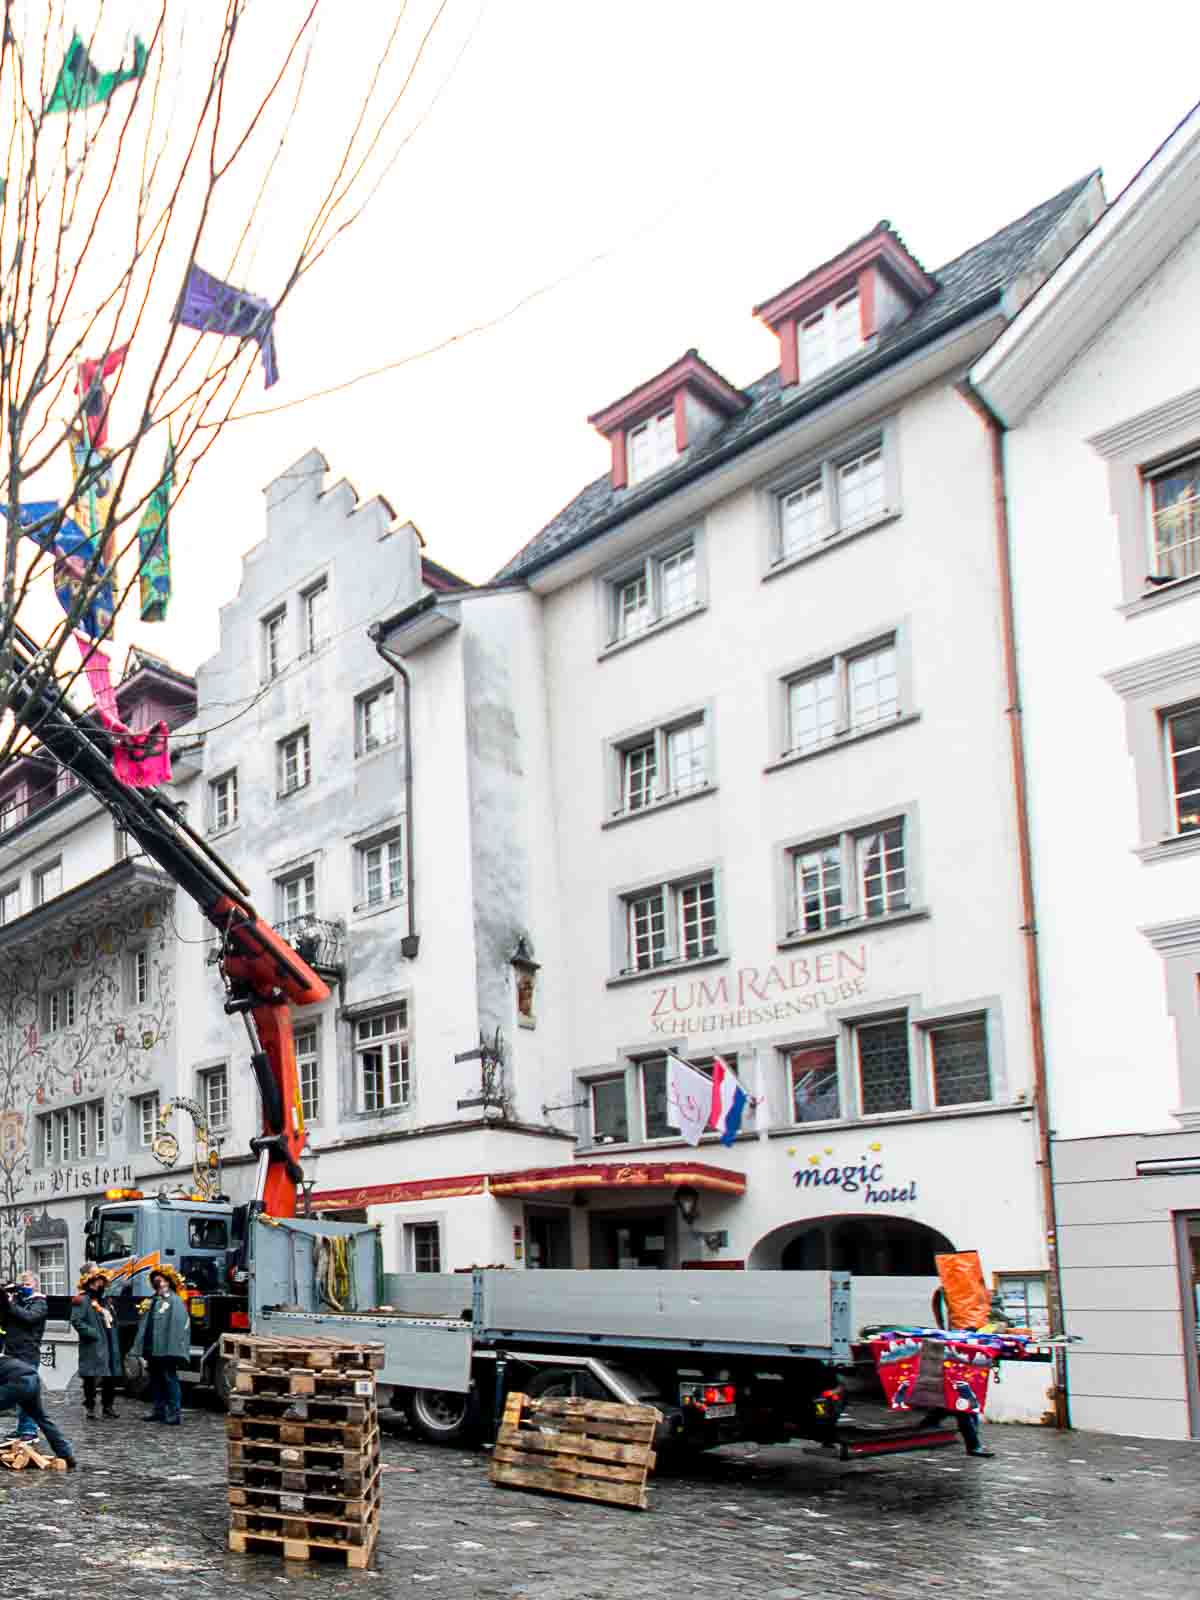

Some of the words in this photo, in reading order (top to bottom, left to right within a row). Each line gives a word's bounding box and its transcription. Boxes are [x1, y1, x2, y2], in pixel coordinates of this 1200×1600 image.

[650, 975, 729, 1017] ZUM
[736, 944, 866, 1006] RABEN
[50, 1165, 133, 1193] Pfistern
[793, 1155, 883, 1192] magic
[865, 1180, 918, 1203] hotel
